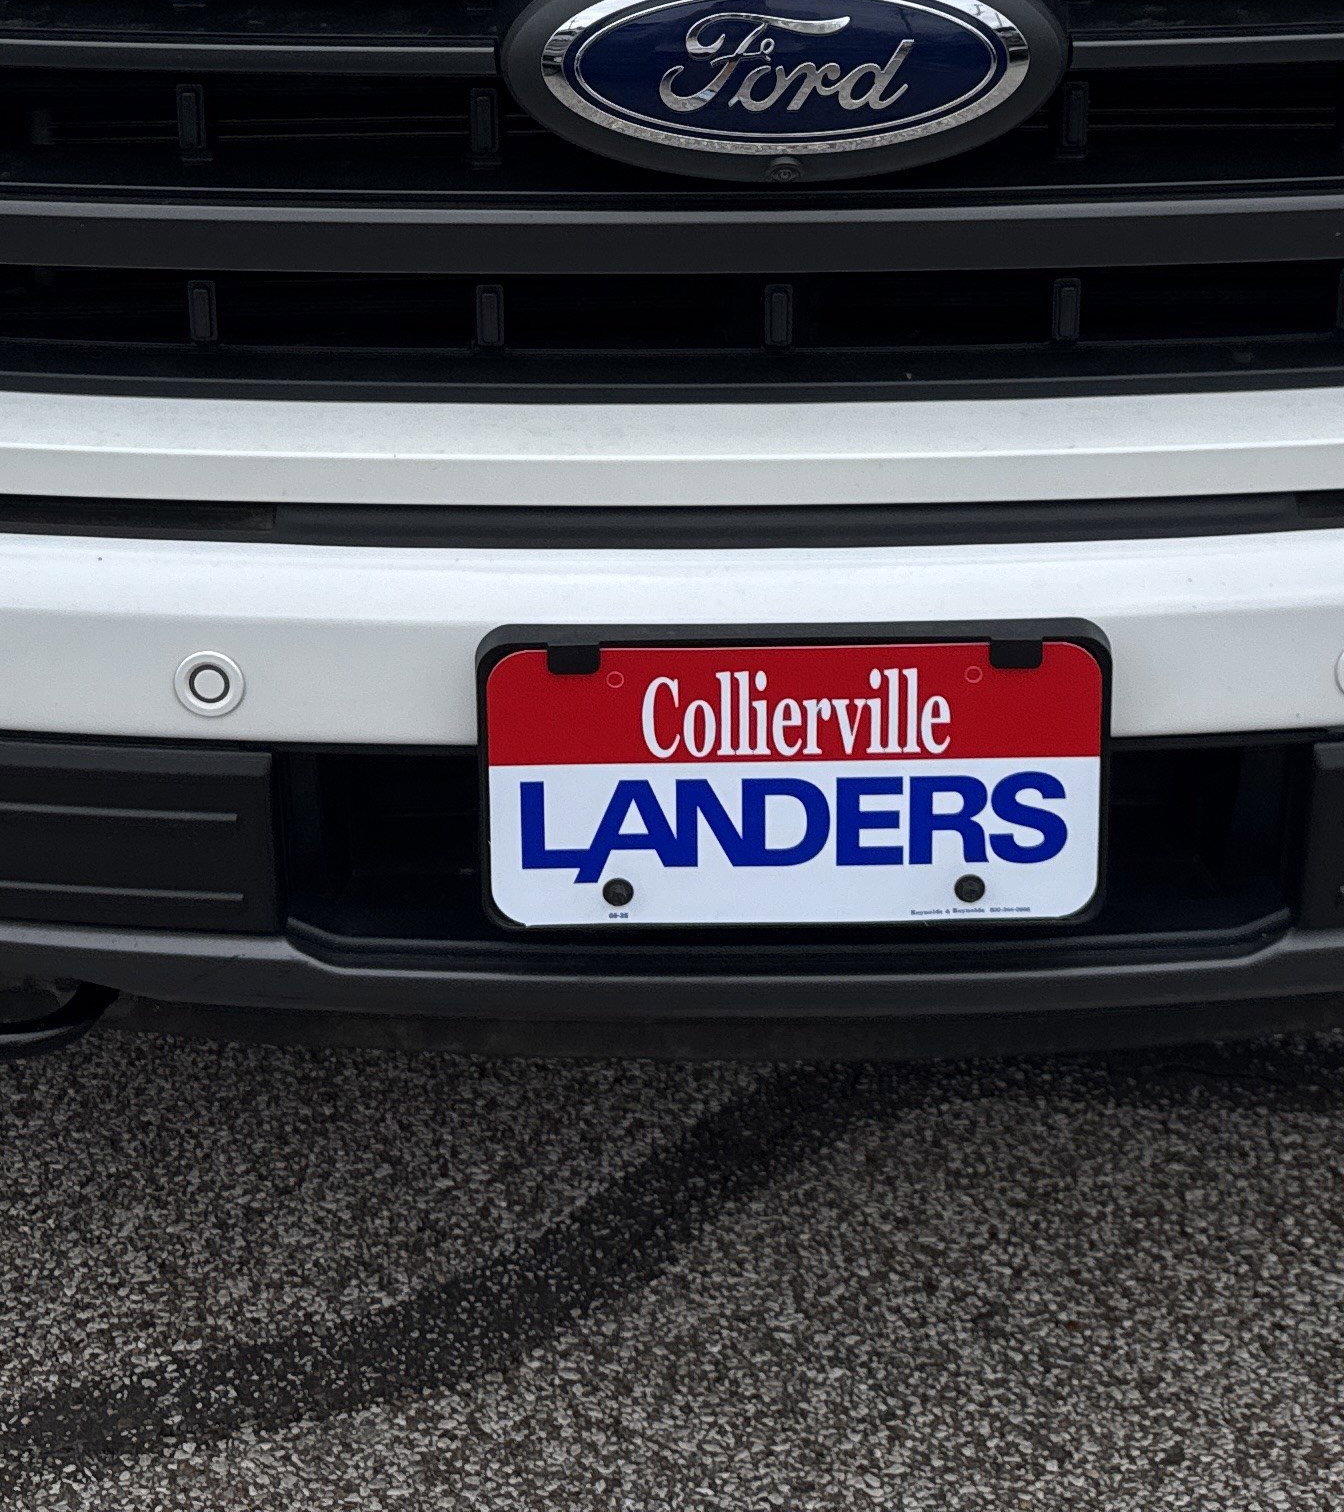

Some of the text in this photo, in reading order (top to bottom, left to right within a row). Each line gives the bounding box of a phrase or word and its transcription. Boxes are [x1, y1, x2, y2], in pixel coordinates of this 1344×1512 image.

[659, 12, 915, 112] Ford
[641, 667, 951, 758] Collierville
[519, 770, 1068, 884] LANDERS
